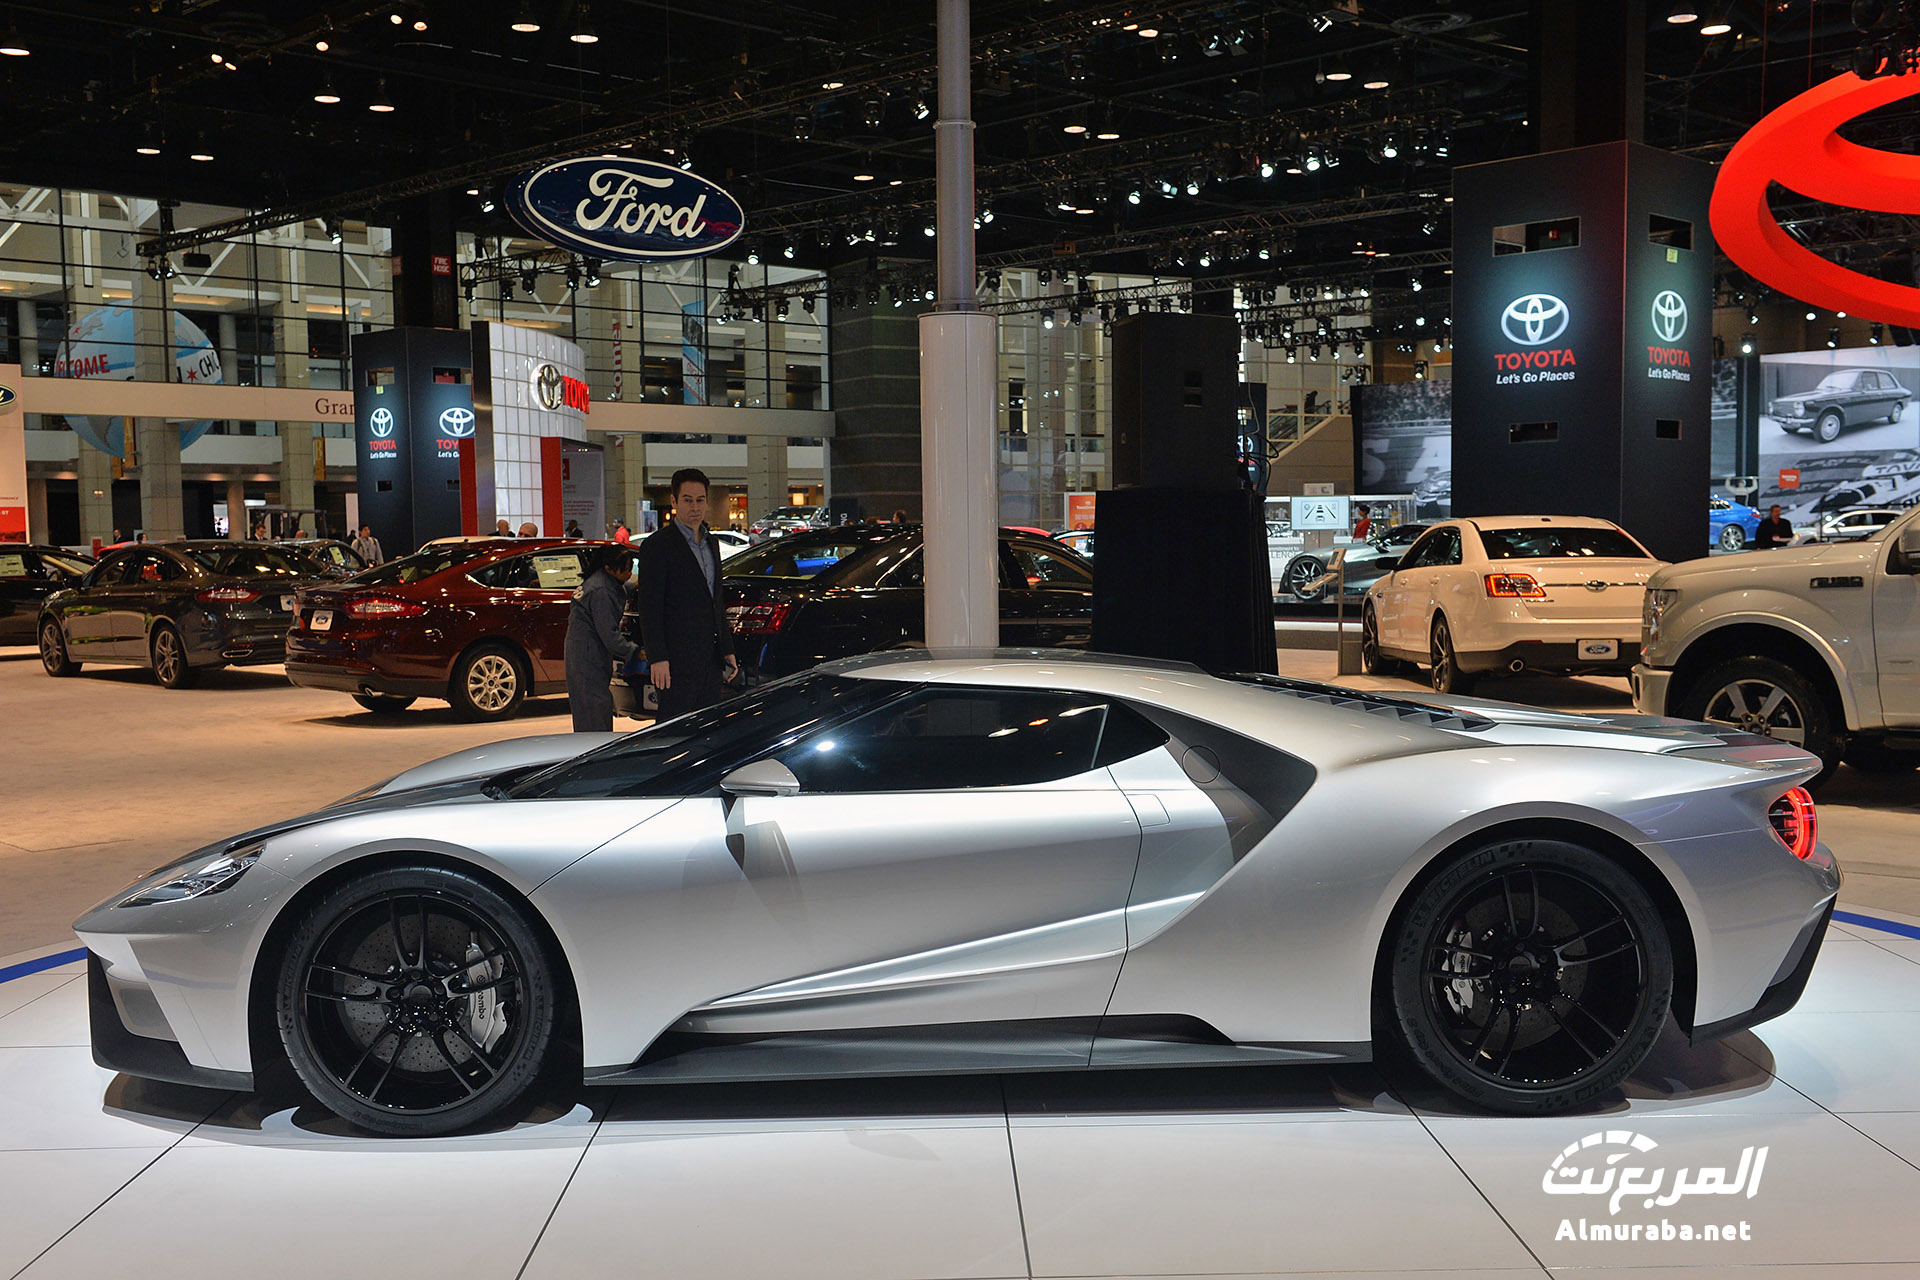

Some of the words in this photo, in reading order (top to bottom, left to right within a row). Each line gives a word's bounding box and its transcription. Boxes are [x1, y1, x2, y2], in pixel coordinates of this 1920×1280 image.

[576, 169, 707, 238] Ford
[1494, 349, 1576, 370] TOYOTA
[1647, 346, 1691, 368] TOYOTA
[1496, 373, 1520, 385] Let's
[1522, 372, 1537, 383] Go
[1539, 371, 1575, 382] Places
[1648, 368, 1662, 379] Let's
[1662, 369, 1671, 379] Go
[1671, 369, 1691, 382] Places
[369, 440, 397, 451] TOYOTA
[436, 439, 459, 450] TOY
[1424, 850, 1495, 906] MICHELIN
